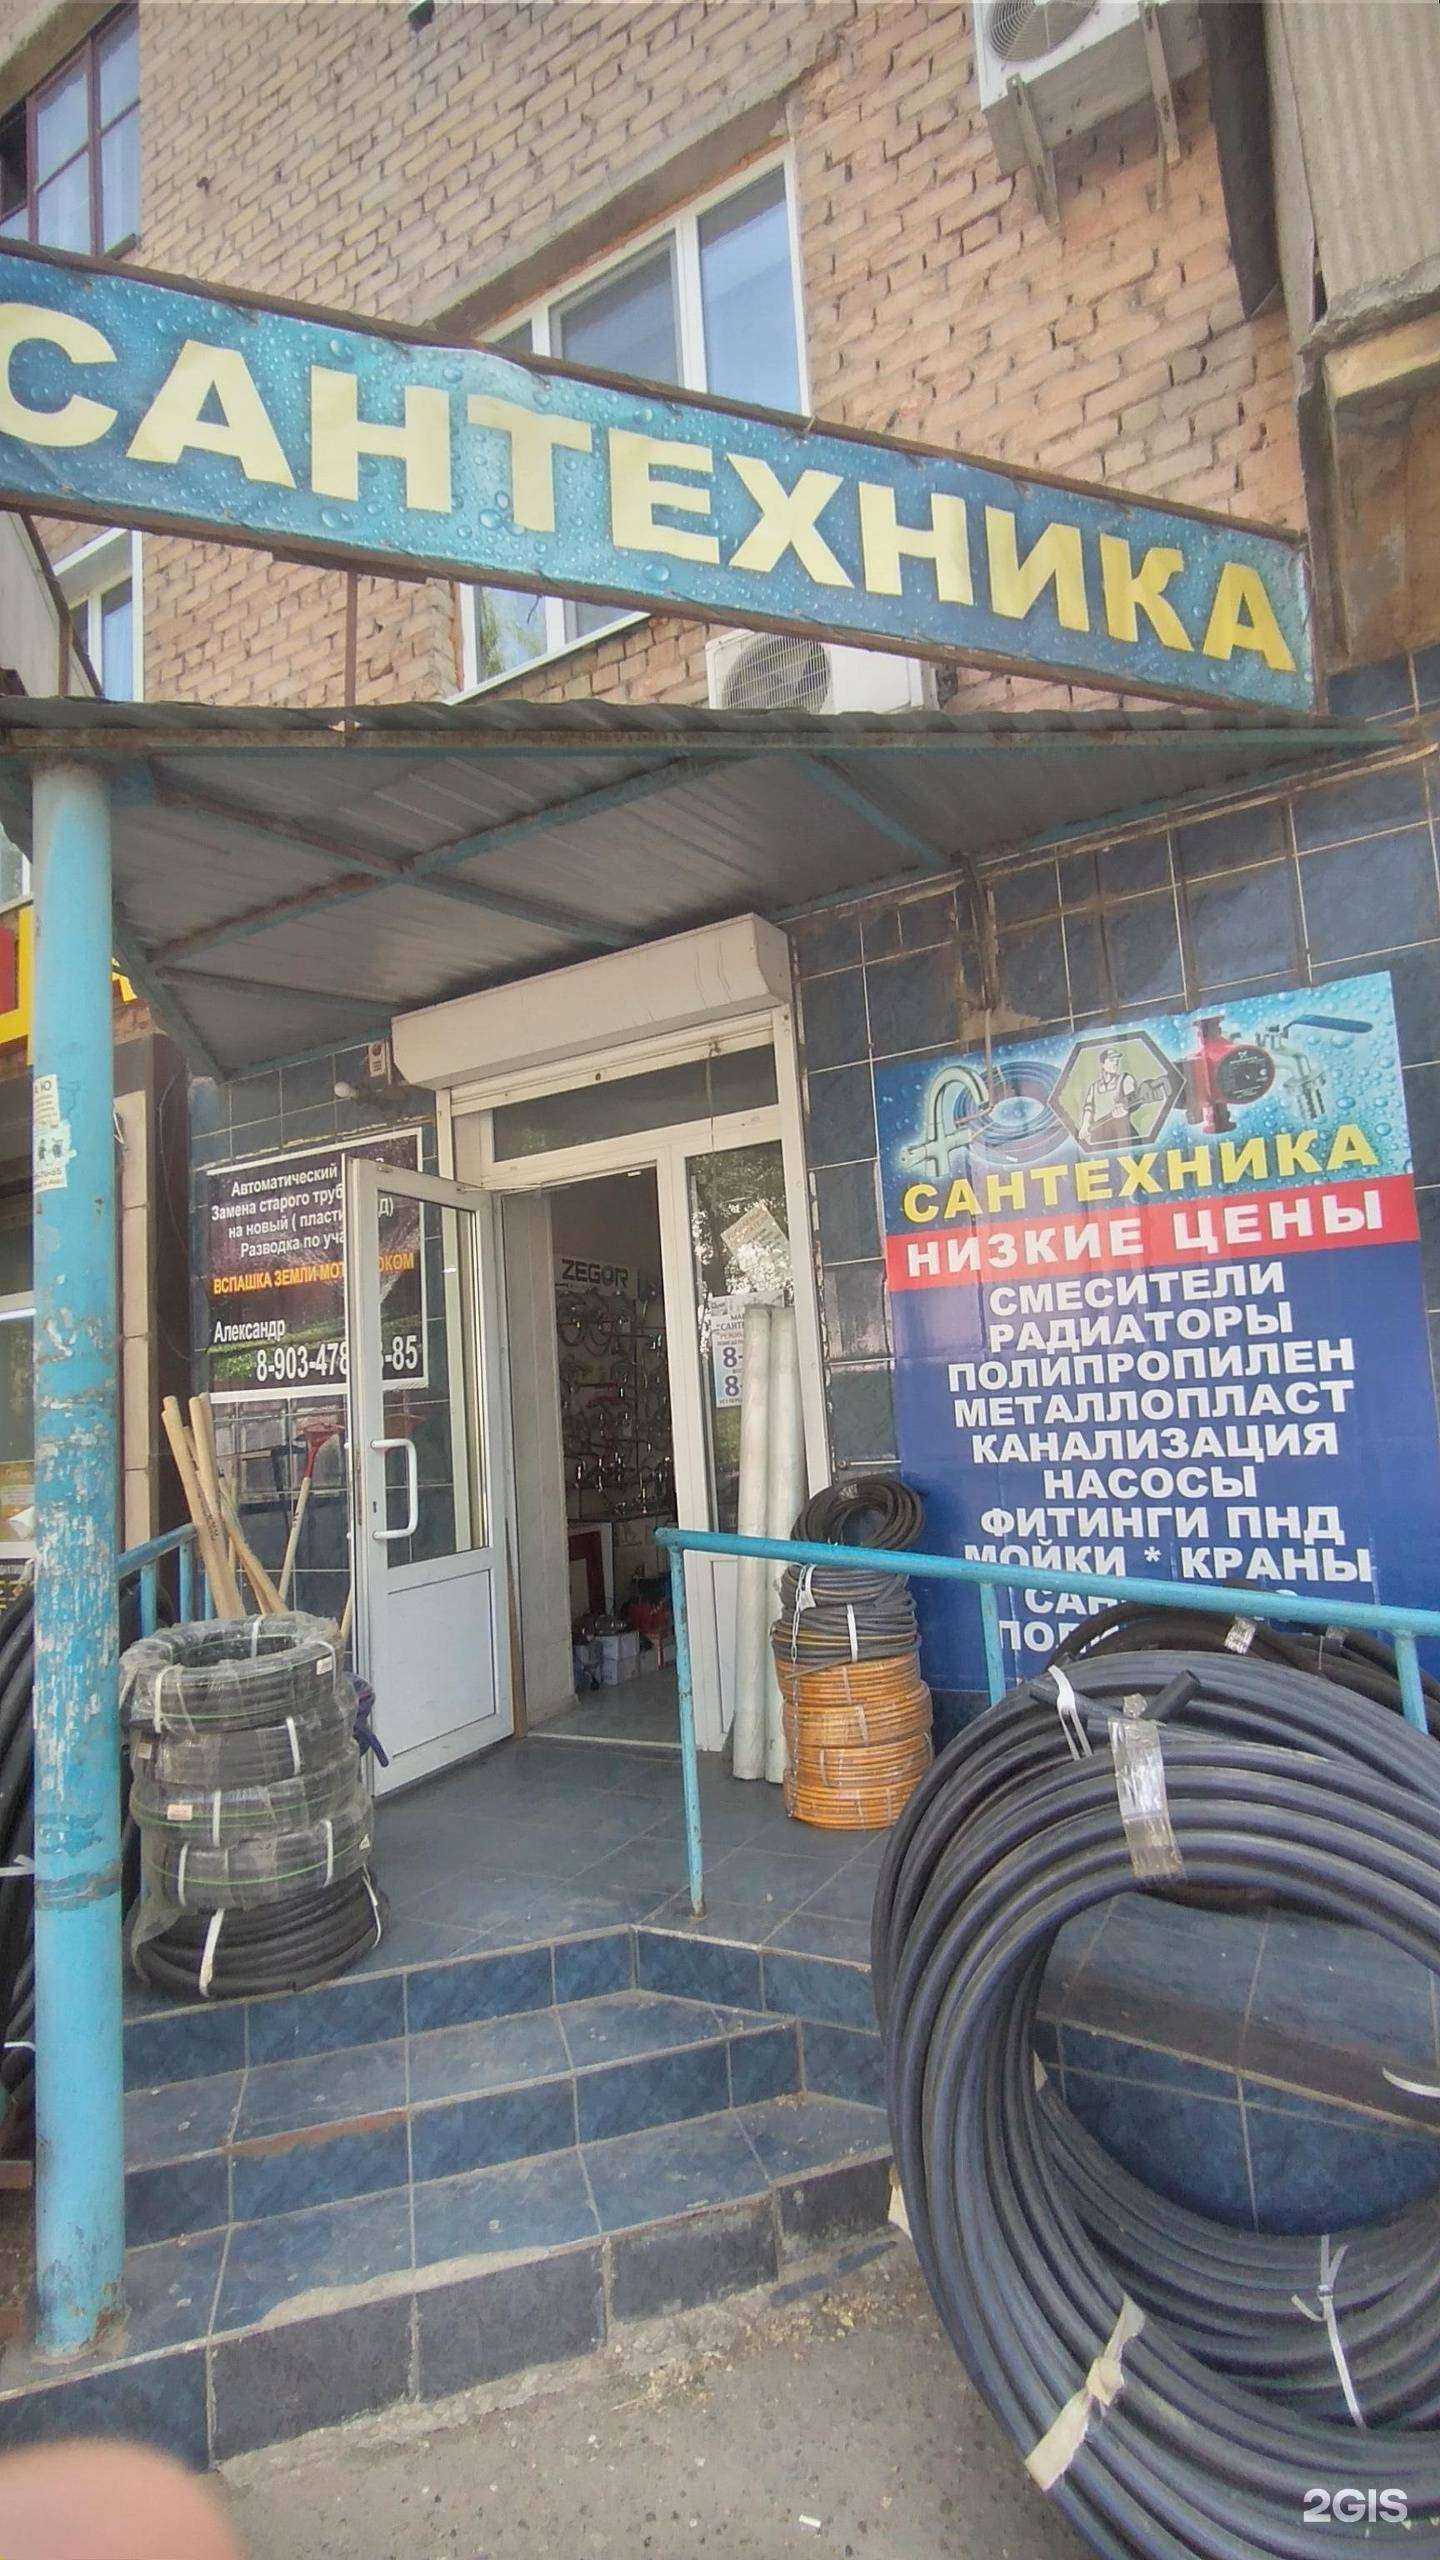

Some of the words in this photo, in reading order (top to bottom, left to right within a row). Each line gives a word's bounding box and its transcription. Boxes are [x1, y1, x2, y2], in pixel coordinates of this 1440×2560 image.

[0, 302, 1296, 672] САНТЕХНИКА
[231, 1163, 338, 1197] Автоматический
[903, 1123, 1379, 1224] САНТЕХНИКА
[211, 1202, 256, 1221] Замена
[259, 1191, 309, 1215] старого
[228, 1224, 243, 1239] на
[246, 1215, 289, 1236] новый
[240, 1237, 300, 1258] Разводка
[303, 1234, 320, 1249] по
[907, 1218, 1144, 1278] НИЗКИЕ
[1172, 1190, 1383, 1256] ЦЕНЫ
[213, 1272, 273, 1295] ВСПАШКА
[561, 1258, 629, 1288] ZEGOR
[989, 1261, 1285, 1316] СМЕСИТЕЛИ
[213, 1319, 286, 1344] Александр
[989, 1301, 1294, 1355] РАДИАТОРЫ
[948, 1337, 1355, 1393] ПОЛИПРОПИЛЕН
[954, 1380, 1355, 1428] МЕТАЛЛОПЛАСТ
[972, 1422, 1339, 1464] КАНАЛИЗАЦИЯ
[1043, 1465, 1257, 1500] НАСОСЫ
[980, 1506, 1210, 1539] ФИТИНГИ
[1227, 1505, 1346, 1546] ПНД
[964, 1538, 1127, 1578] МОЙКИ
[1180, 1547, 1373, 1583] КРАНЫ
